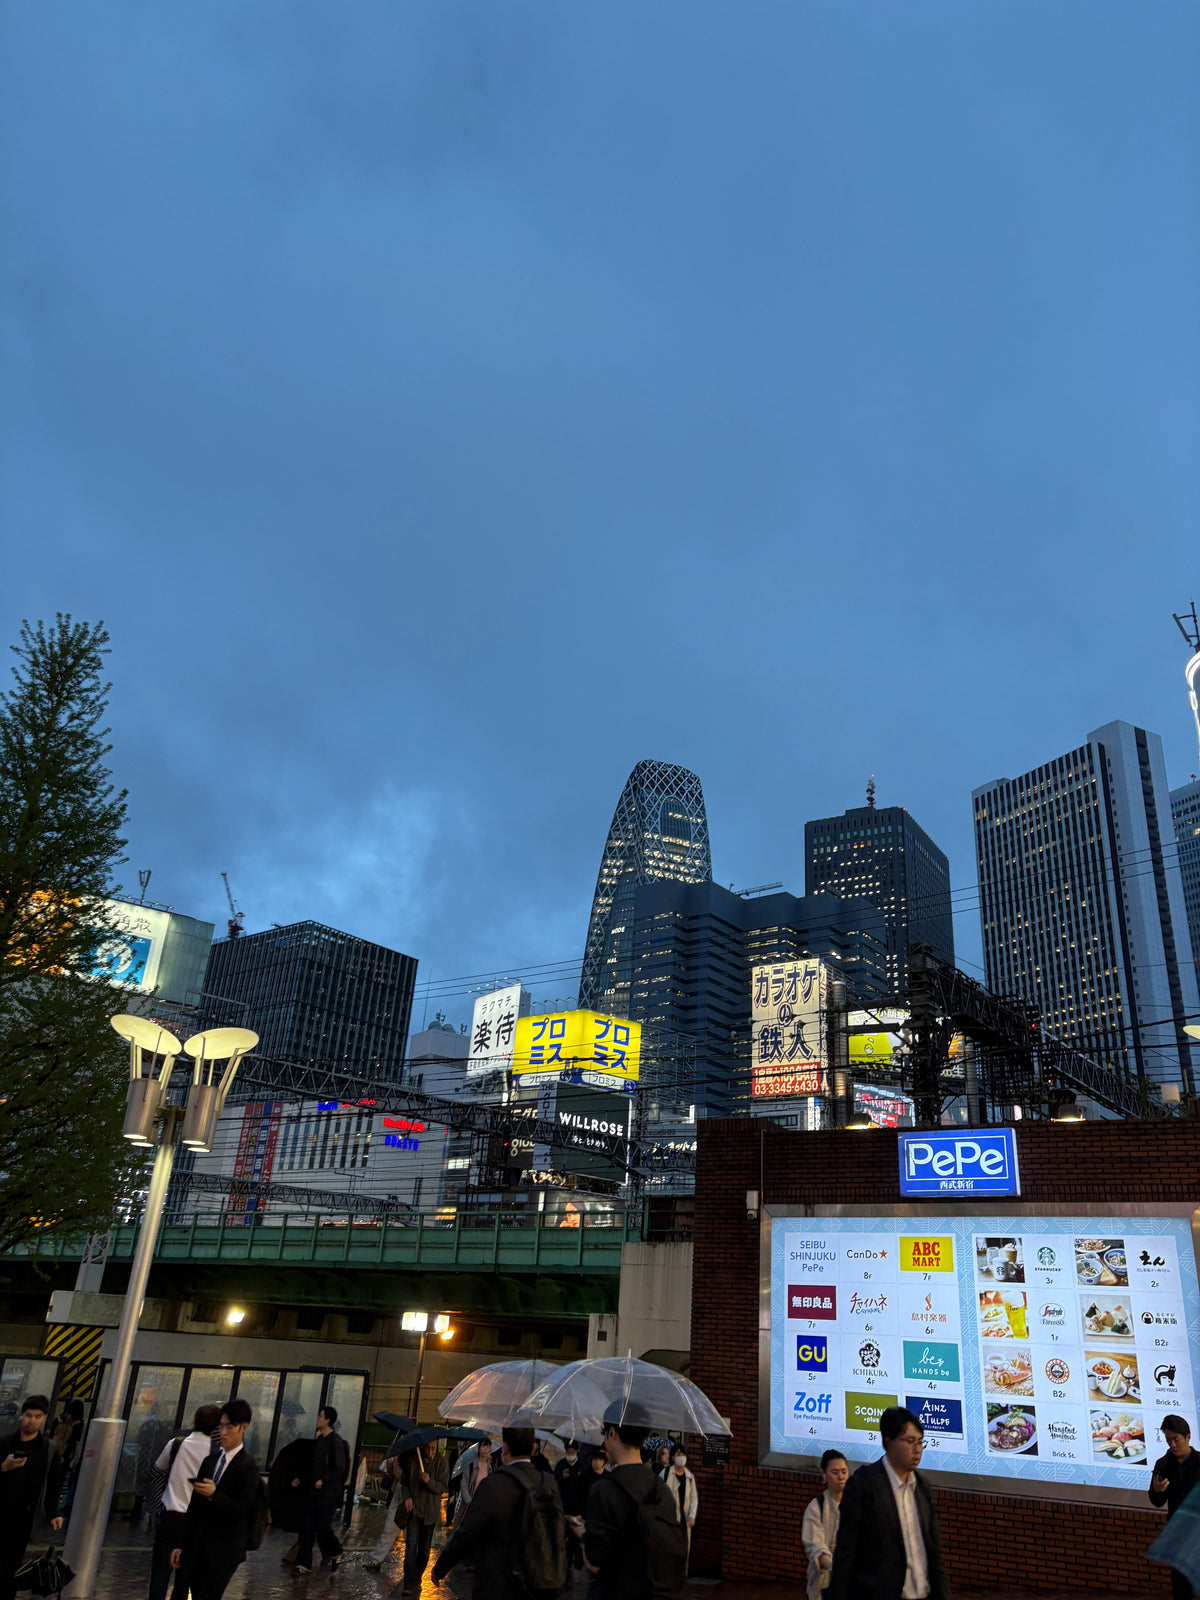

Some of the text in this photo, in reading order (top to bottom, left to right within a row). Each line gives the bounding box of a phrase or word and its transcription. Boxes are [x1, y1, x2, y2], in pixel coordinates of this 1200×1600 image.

[753, 963, 818, 1007] カラオケ
[481, 995, 512, 1015] ラクマチ
[777, 1002, 793, 1026] の
[473, 1011, 515, 1054] 楽待
[532, 1017, 567, 1042] プロ
[594, 1018, 630, 1047] プロ
[758, 1021, 814, 1064] 鉄人
[529, 1043, 564, 1065] ミス
[592, 1043, 628, 1071] ミス
[591, 1074, 617, 1087] プロミス
[754, 1080, 819, 1096] 03-3345-6430
[559, 1111, 624, 1137] WILLROSE
[908, 1141, 1004, 1176] PePe
[800, 1240, 826, 1249] SEIBU
[911, 1241, 941, 1256] ABC
[790, 1251, 836, 1261] SHINJUKU
[912, 1257, 941, 1267] MART
[802, 1264, 824, 1272] PePe
[863, 1271, 872, 1280] 8F
[922, 1273, 932, 1281] 7F
[1045, 1277, 1054, 1285] 3F
[1151, 1280, 1160, 1288] 2F
[791, 1295, 833, 1309] 無印良品
[850, 1292, 888, 1314] チャイハネ
[807, 1321, 816, 1329] 7F
[865, 1324, 874, 1332] 6F
[925, 1327, 934, 1335] 6F
[1154, 1338, 1169, 1347] B2F
[798, 1344, 826, 1363] GU
[852, 1368, 888, 1378] ICHIKURA
[912, 1367, 939, 1376] HANDS
[808, 1373, 817, 1381] 5F
[866, 1377, 876, 1386] 4F
[927, 1382, 937, 1391] 4F
[1052, 1390, 1066, 1398] B2F
[793, 1391, 832, 1413] Zoff
[793, 1413, 803, 1421] Eye
[808, 1426, 817, 1435] 4F
[868, 1432, 877, 1441] 3F
[930, 1438, 940, 1447] 3F
[1052, 1450, 1067, 1458] Brick
